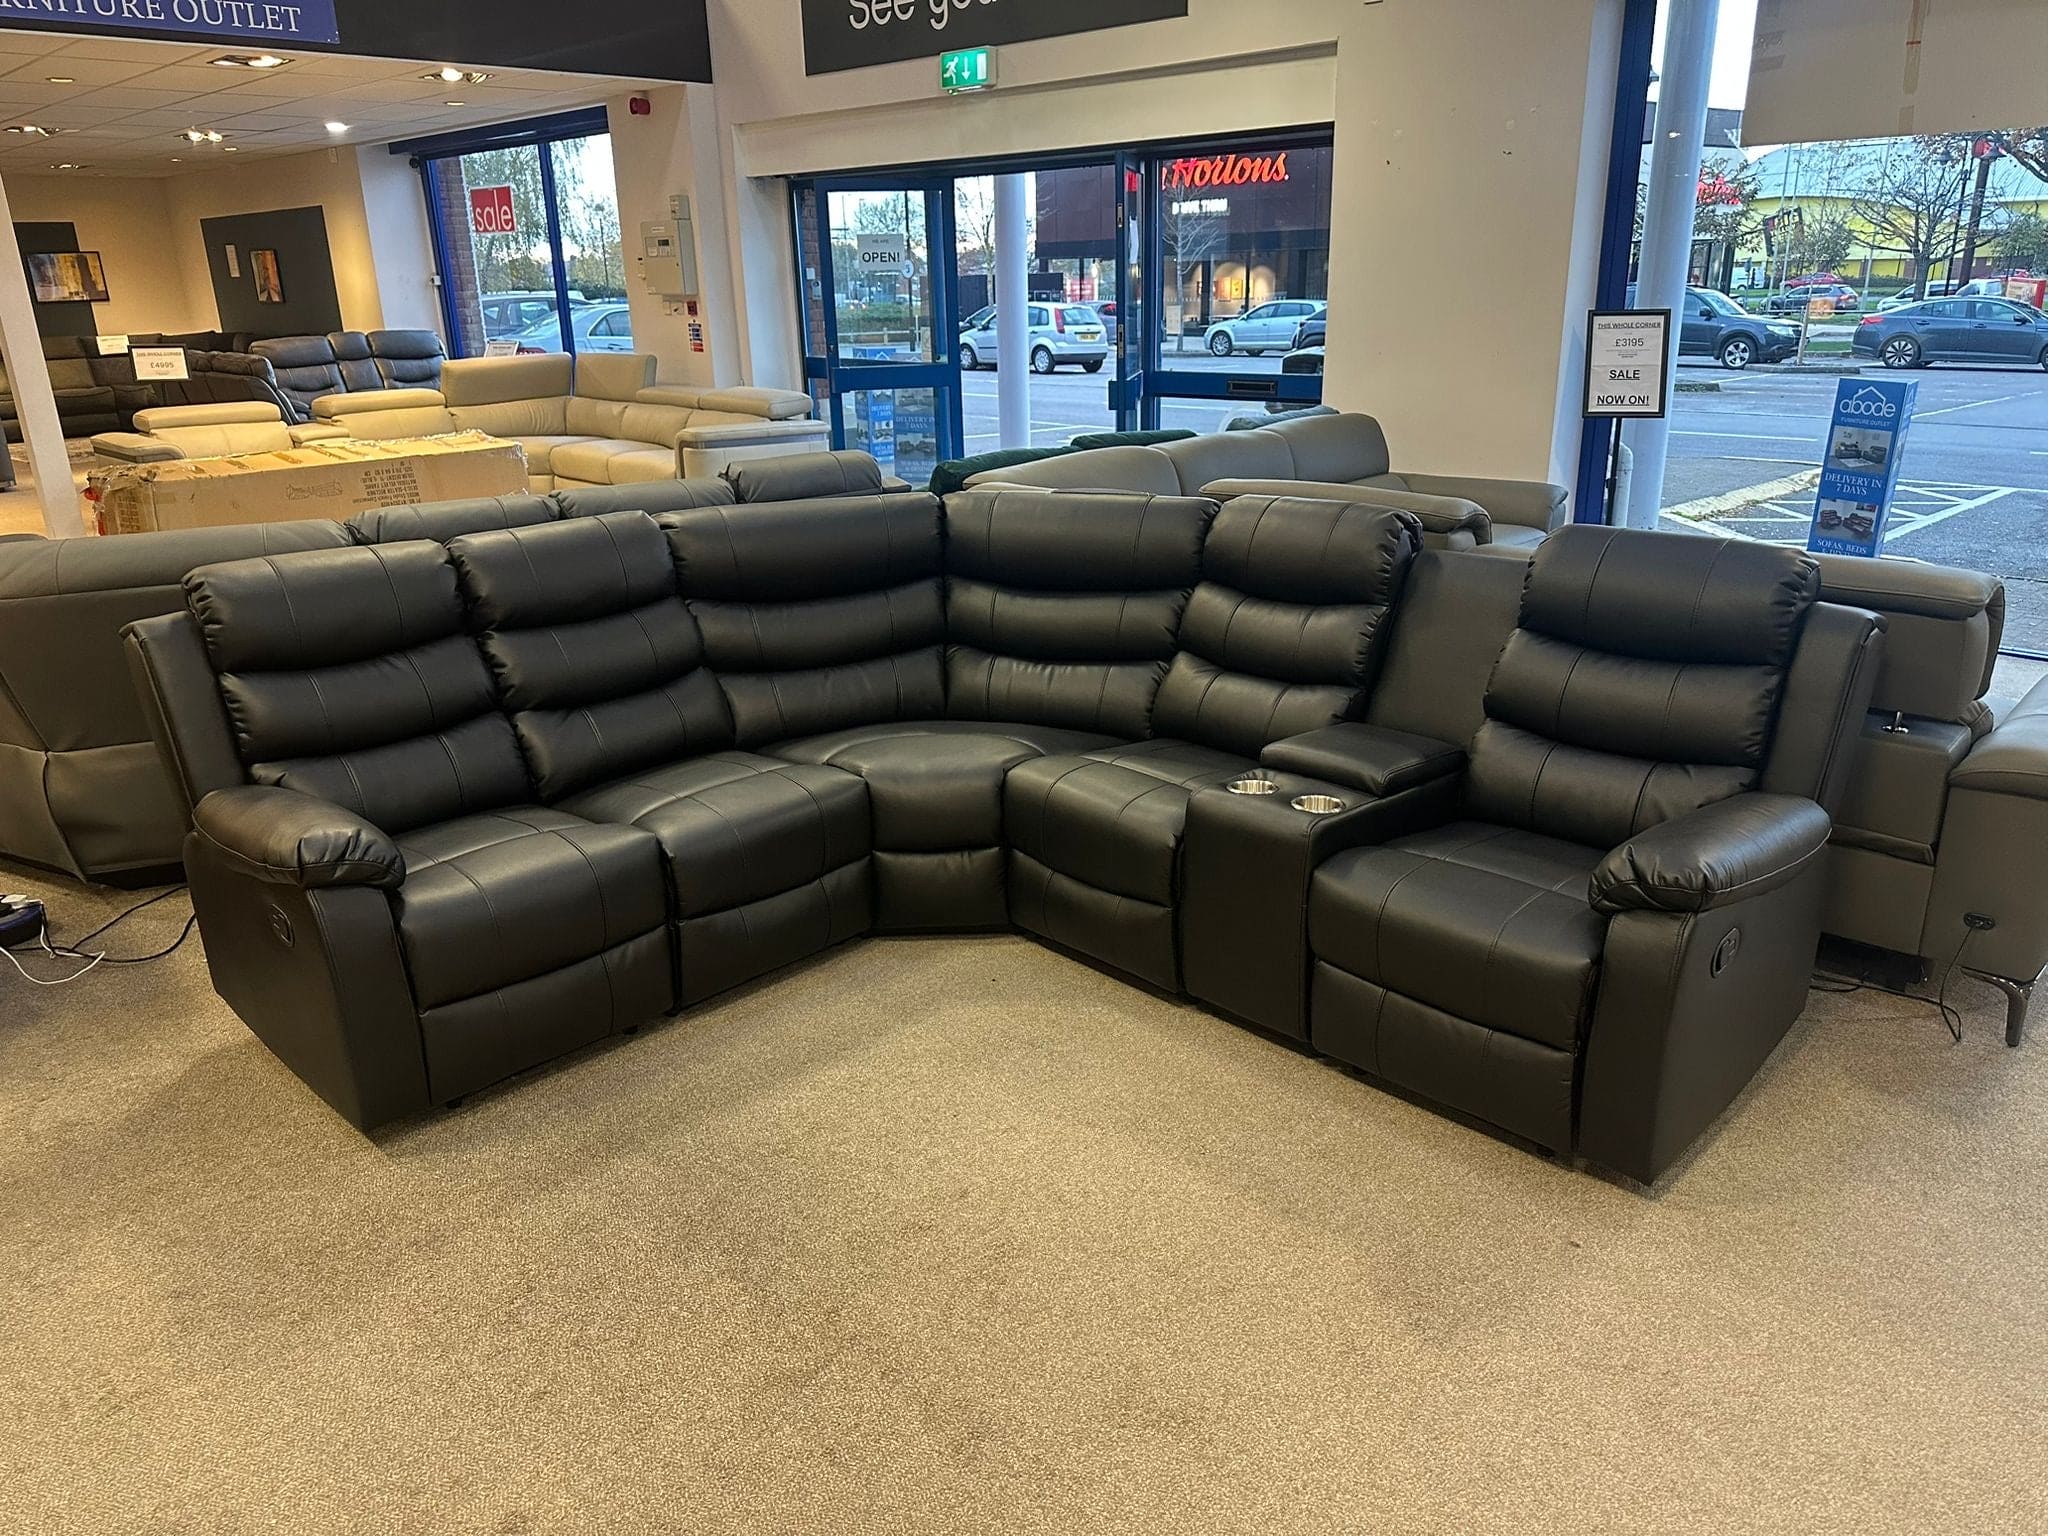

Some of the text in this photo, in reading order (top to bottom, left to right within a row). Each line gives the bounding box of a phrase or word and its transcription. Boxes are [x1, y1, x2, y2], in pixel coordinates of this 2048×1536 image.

[173, 0, 301, 32] OUTLET
[475, 189, 512, 231] sale
[862, 252, 900, 263] OPEN!
[1615, 337, 1644, 347] £3195
[1608, 369, 1641, 380] SALE
[1597, 395, 1650, 405] NOW ON!
[1839, 397, 1896, 417] abode
[1825, 473, 1883, 489] DELIVERY IN
[1836, 482, 1868, 496] 7 DAYS
